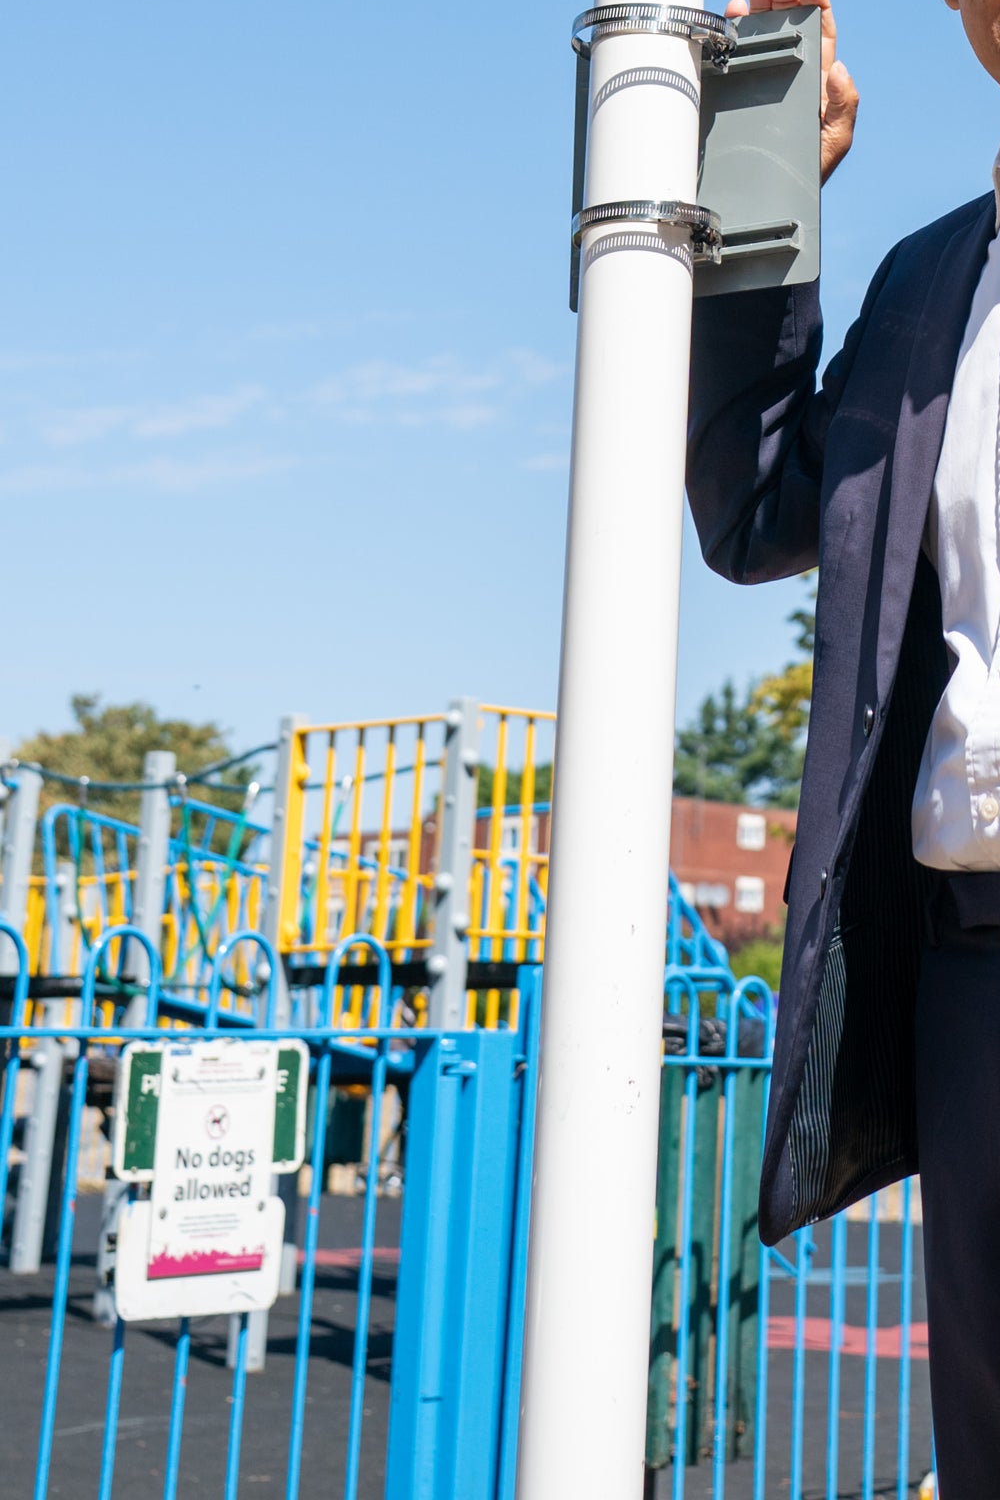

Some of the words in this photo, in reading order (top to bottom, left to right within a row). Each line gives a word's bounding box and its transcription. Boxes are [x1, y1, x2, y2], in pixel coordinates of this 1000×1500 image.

[175, 1147, 202, 1169] No
[208, 1143, 255, 1172] dogs
[174, 1174, 252, 1202] allowed
